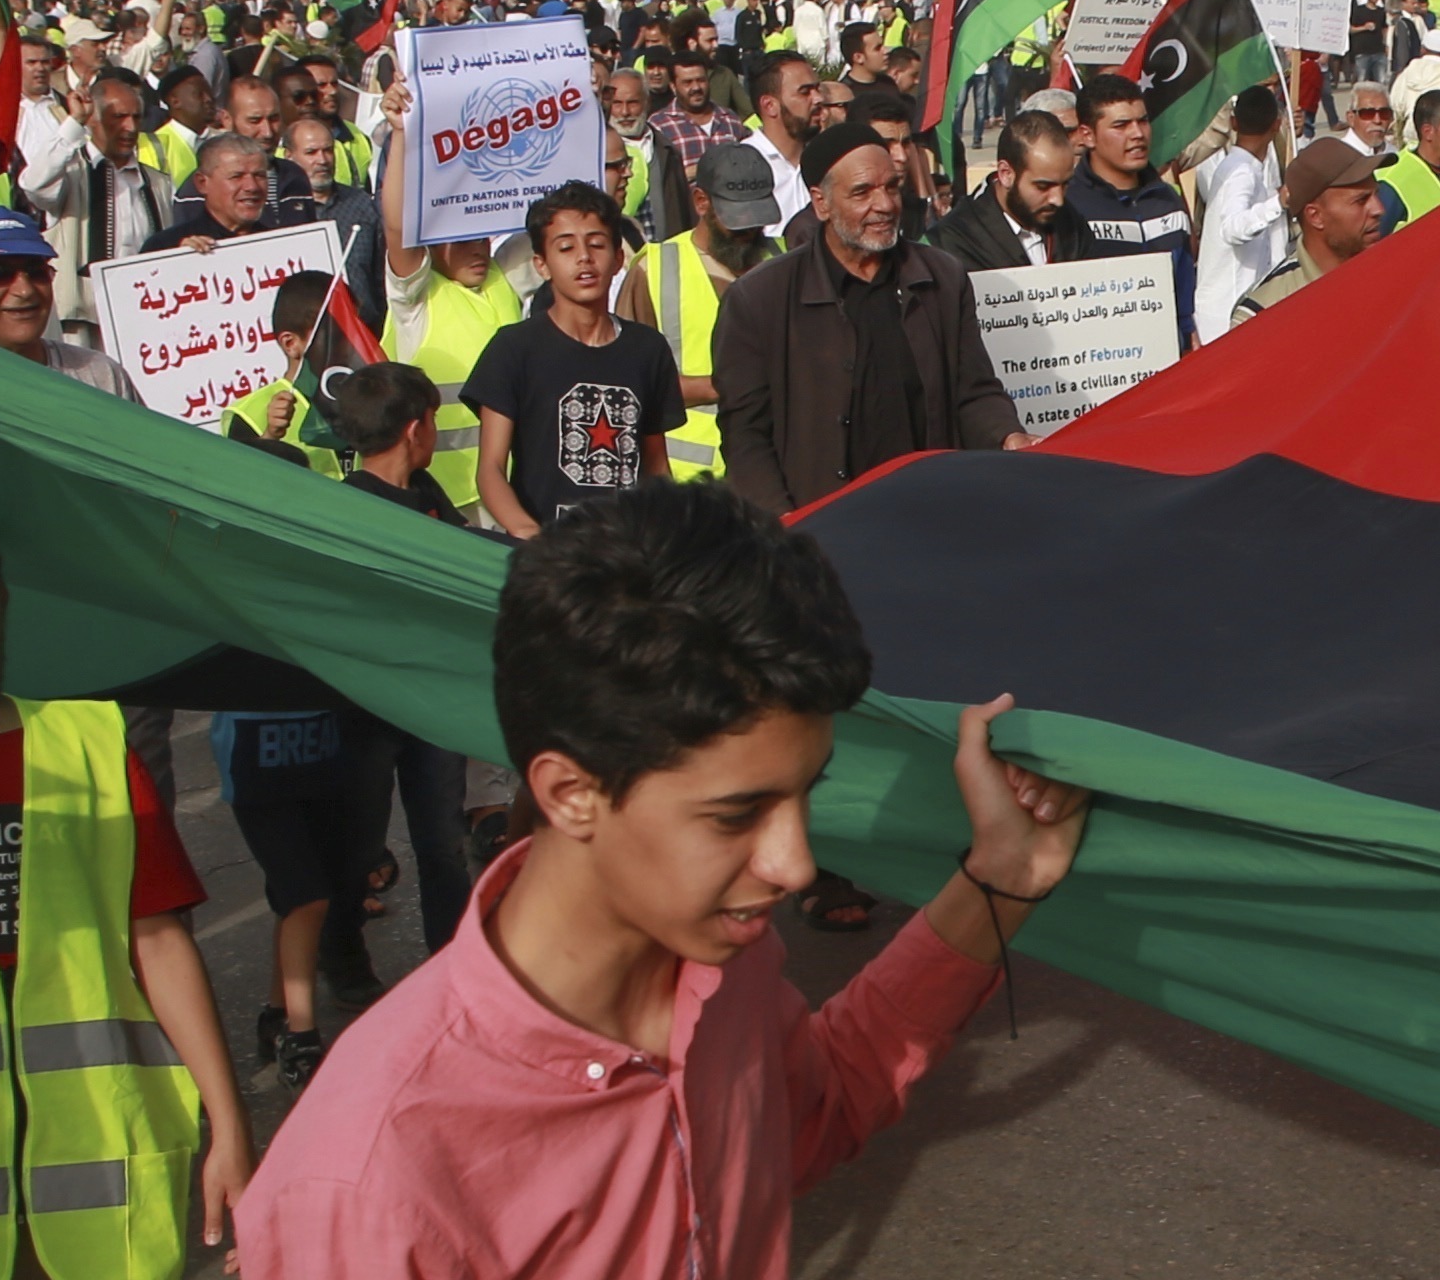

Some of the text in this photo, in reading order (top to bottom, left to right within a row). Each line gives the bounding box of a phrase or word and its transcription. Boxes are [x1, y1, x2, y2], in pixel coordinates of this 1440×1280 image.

[1111, 17, 1147, 26] FREEDOM
[1116, 31, 1125, 39] the
[1125, 31, 1144, 41] poli
[1073, 43, 1106, 54] (project)
[421, 42, 588, 76] بعثة الأمم المتحدة للهدم في ليبيا
[432, 78, 584, 165] Dégagé
[431, 193, 468, 207] UNITED
[472, 187, 519, 201] NATIONS
[464, 202, 509, 216] MISSION
[512, 200, 524, 210] IN
[984, 276, 1155, 308] حلم ثورة فبراير هو الدولة المدنية
[1072, 305, 1109, 322] والعدل
[1111, 301, 1138, 318] القيم
[1140, 300, 1163, 314] دولة
[139, 324, 218, 375] مشروع
[1002, 345, 1144, 374] The dream of February
[181, 368, 252, 418] فبراير
[1055, 380, 1067, 393] is
[1070, 380, 1077, 392] a
[1081, 373, 1127, 391] civilian
[1024, 410, 1035, 425] A
[1037, 406, 1070, 424] state
[1073, 403, 1088, 419] of
